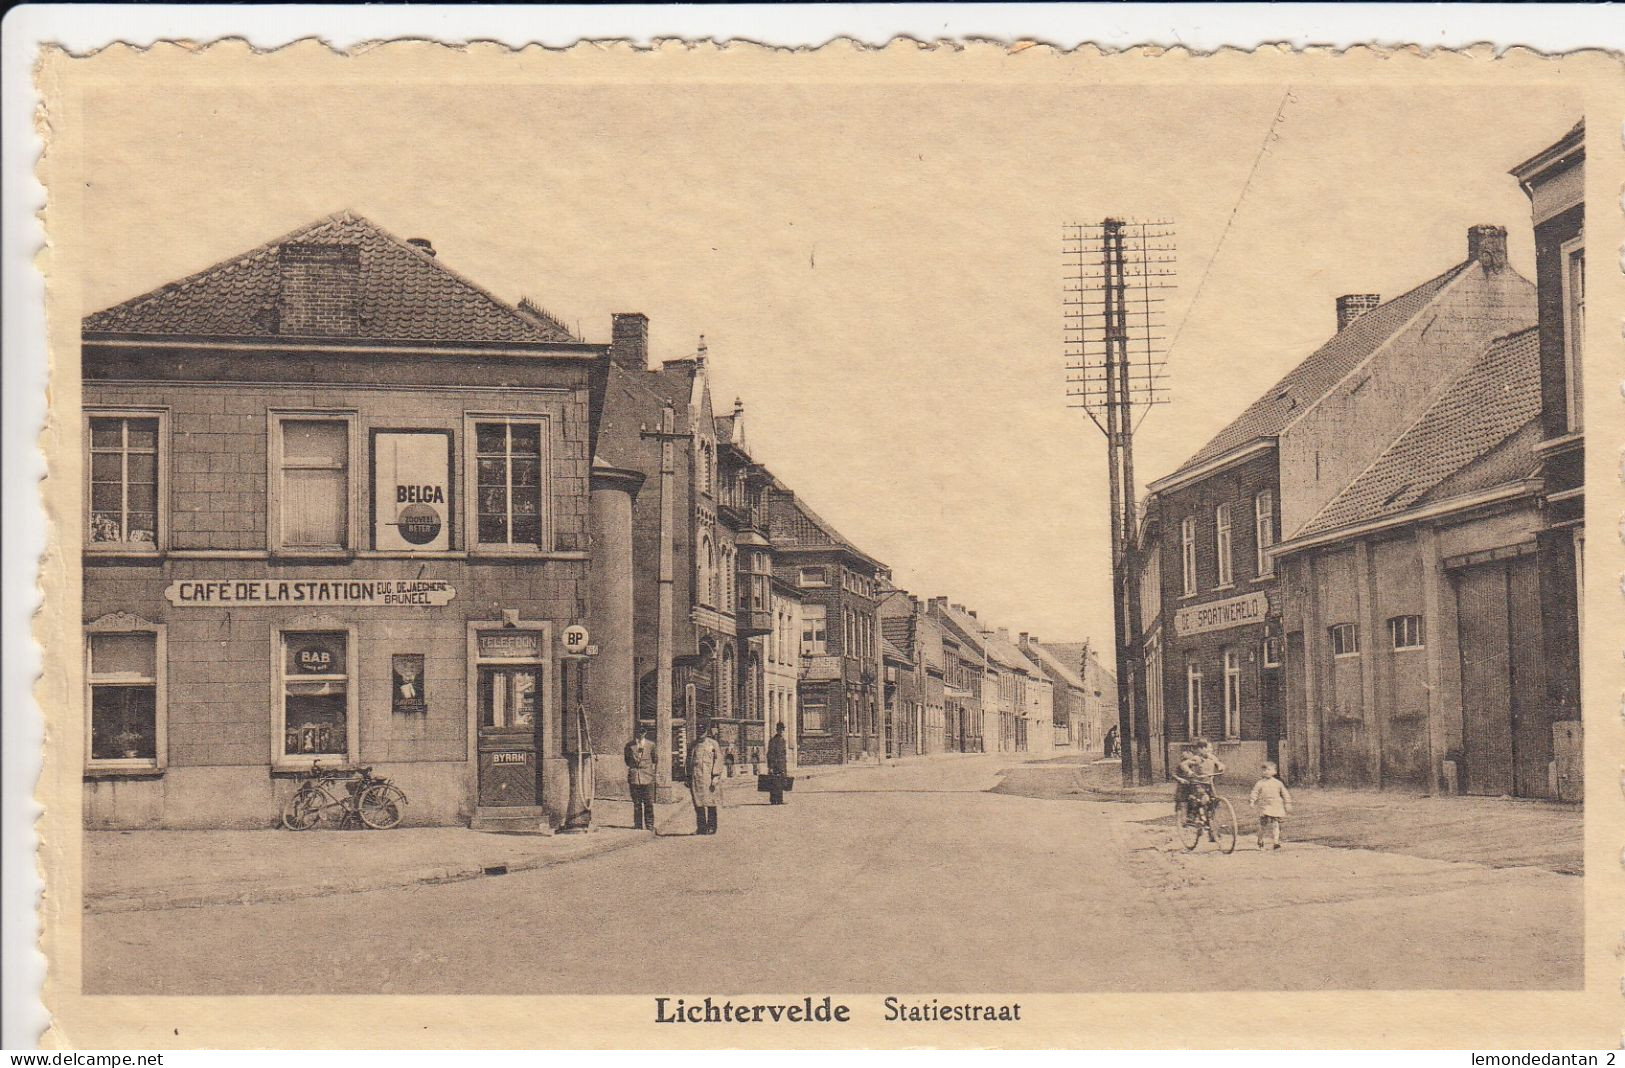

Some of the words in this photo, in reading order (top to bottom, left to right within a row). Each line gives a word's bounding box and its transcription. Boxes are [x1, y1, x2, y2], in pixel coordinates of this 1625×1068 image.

[397, 485, 444, 503] BELGA
[235, 582, 261, 600] DE
[265, 582, 290, 600] LA
[293, 582, 374, 600] STATION
[384, 592, 432, 605] BRUNEEL
[567, 632, 583, 646] BP
[301, 651, 331, 663] BAB
[493, 753, 525, 763] BYRRH
